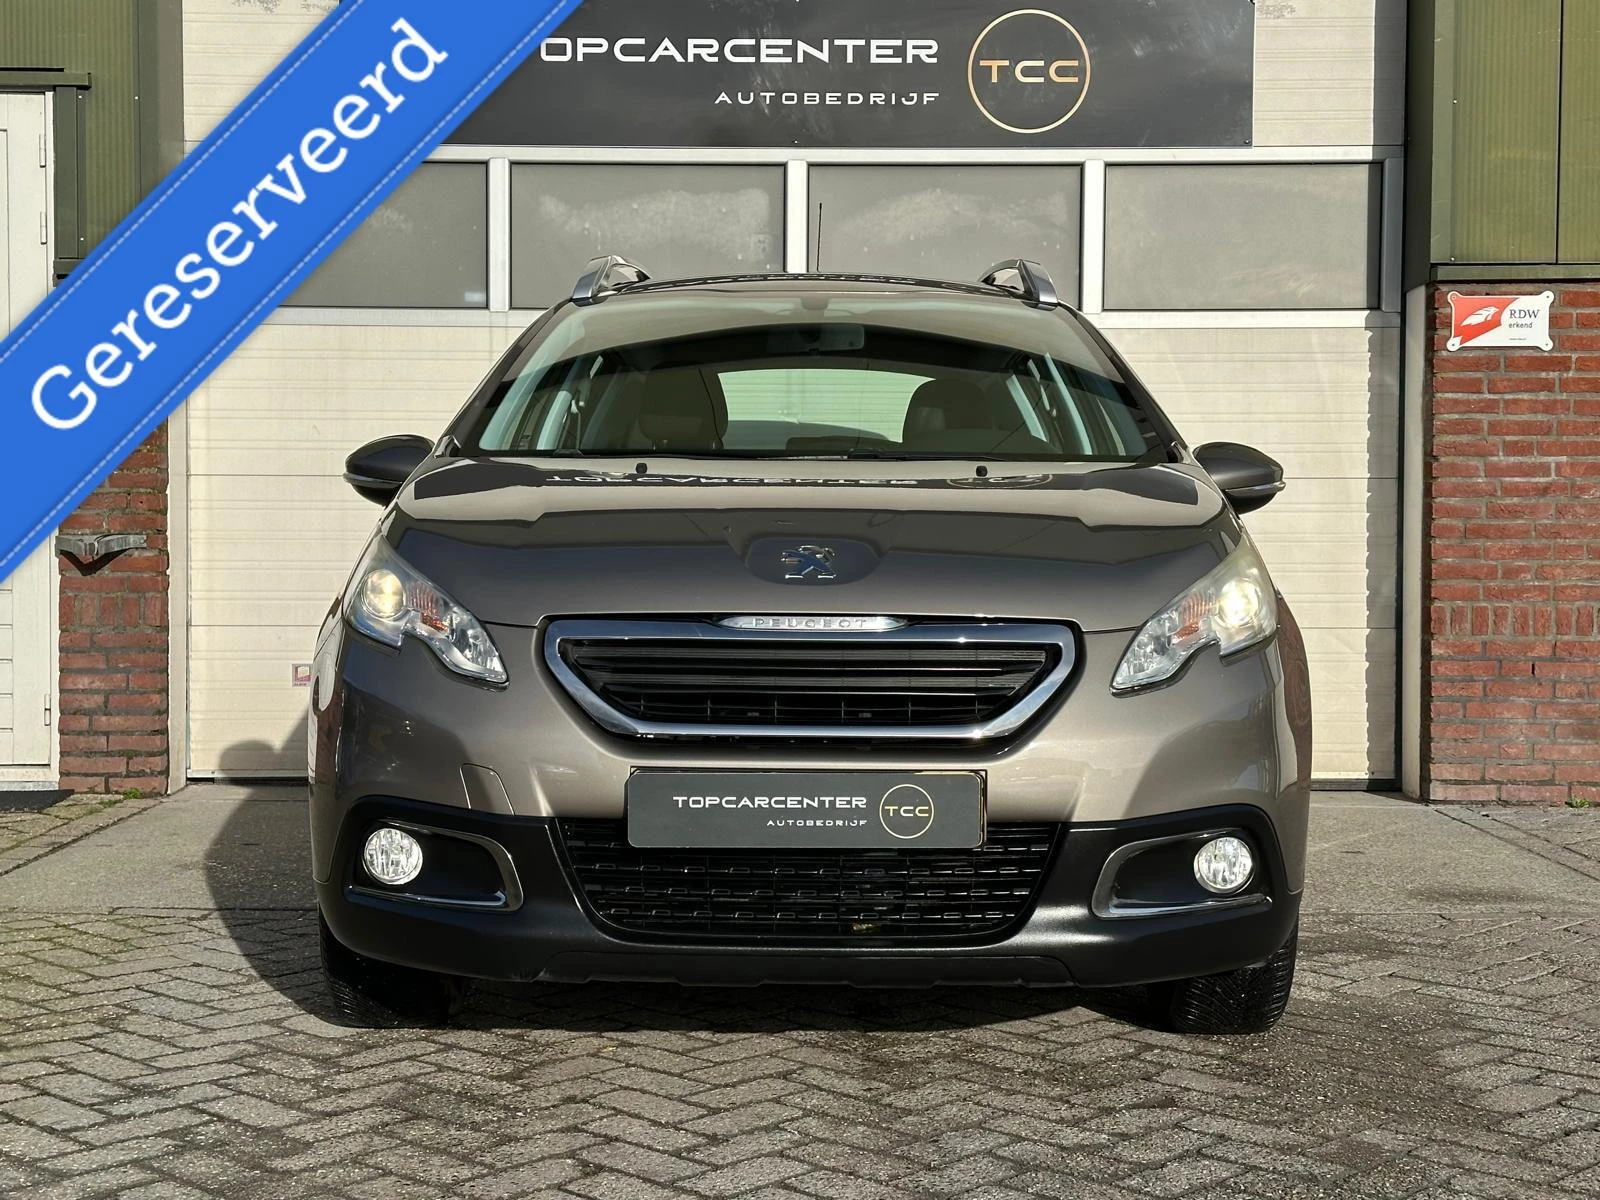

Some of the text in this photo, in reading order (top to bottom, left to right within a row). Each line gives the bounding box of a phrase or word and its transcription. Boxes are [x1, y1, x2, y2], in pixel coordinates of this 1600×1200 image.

[540, 37, 939, 63] OPCARCENTER
[979, 60, 1079, 83] TCC
[714, 91, 940, 106] AUTOBEDRIJF
[1509, 308, 1540, 318] RDW
[1508, 321, 1533, 329] erkend
[753, 617, 867, 628] PEUGEOT
[672, 796, 867, 809] TOPCARCENTER
[884, 805, 929, 817] TCC
[766, 819, 868, 827] AUTOBEDRIJF
